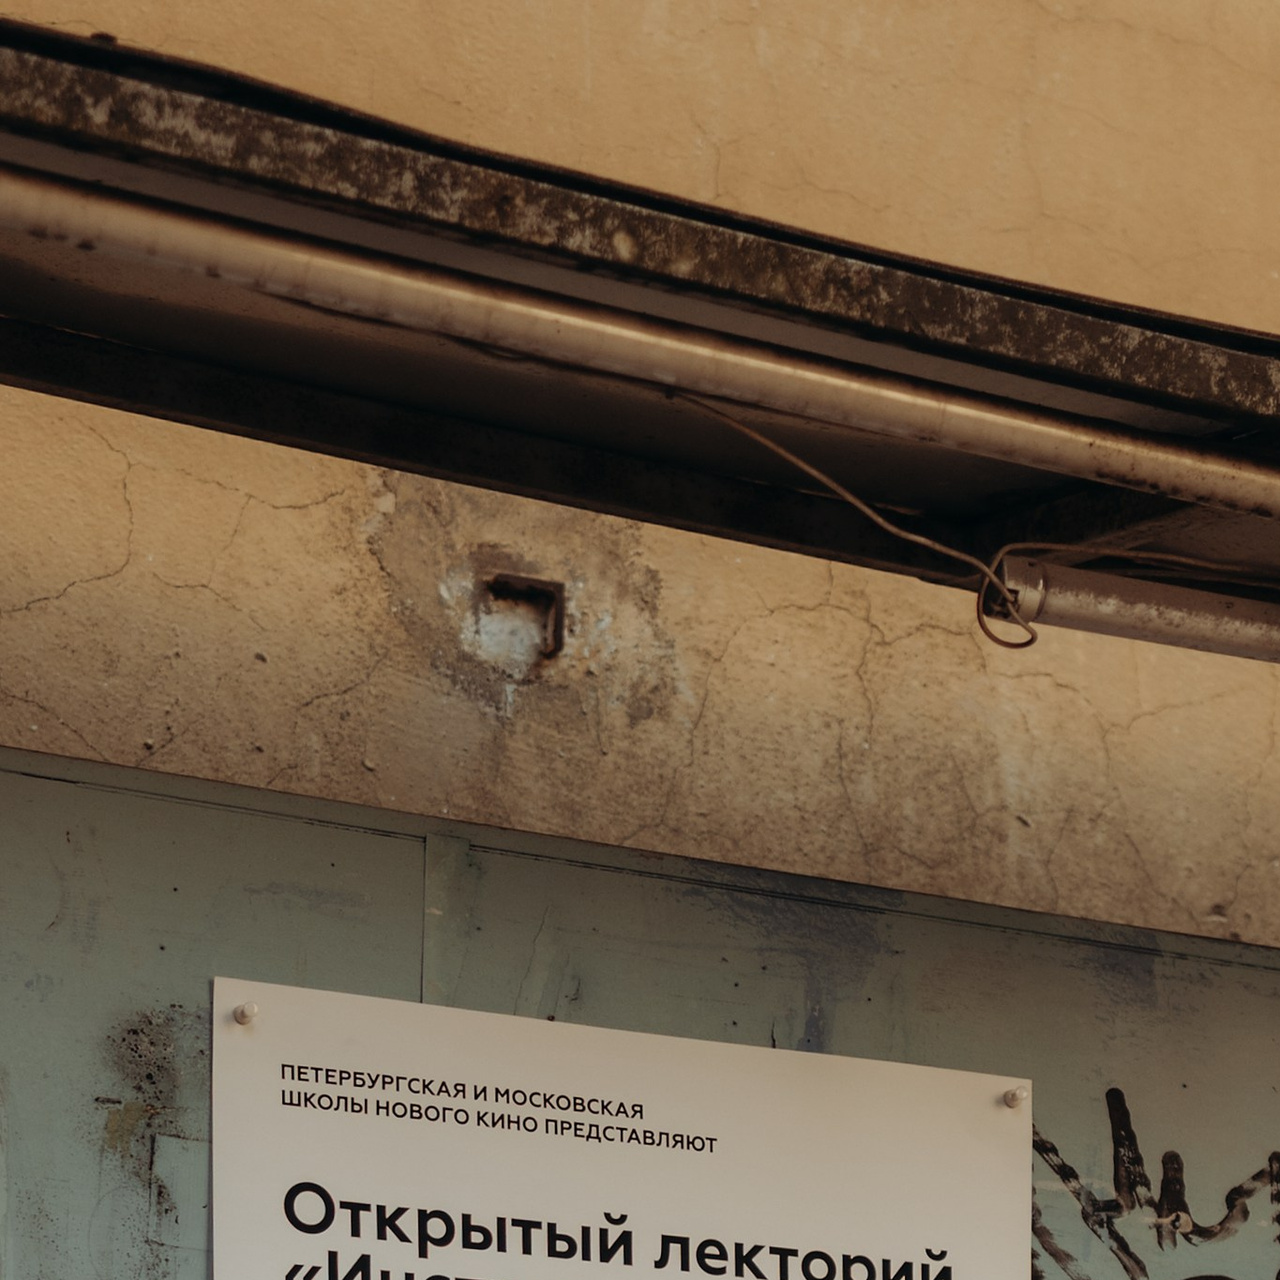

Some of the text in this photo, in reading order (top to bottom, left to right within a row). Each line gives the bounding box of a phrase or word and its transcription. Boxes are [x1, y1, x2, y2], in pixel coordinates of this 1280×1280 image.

[280, 1063, 644, 1120] ПЕТЕРБУРГСКАЯ И МОСКОВСКАЯ
[281, 1089, 717, 1154] ШКОЛЫ НОВОГО КИНО ПРЕДСТАВЛЯЮТ
[283, 1181, 634, 1267] Открытый
